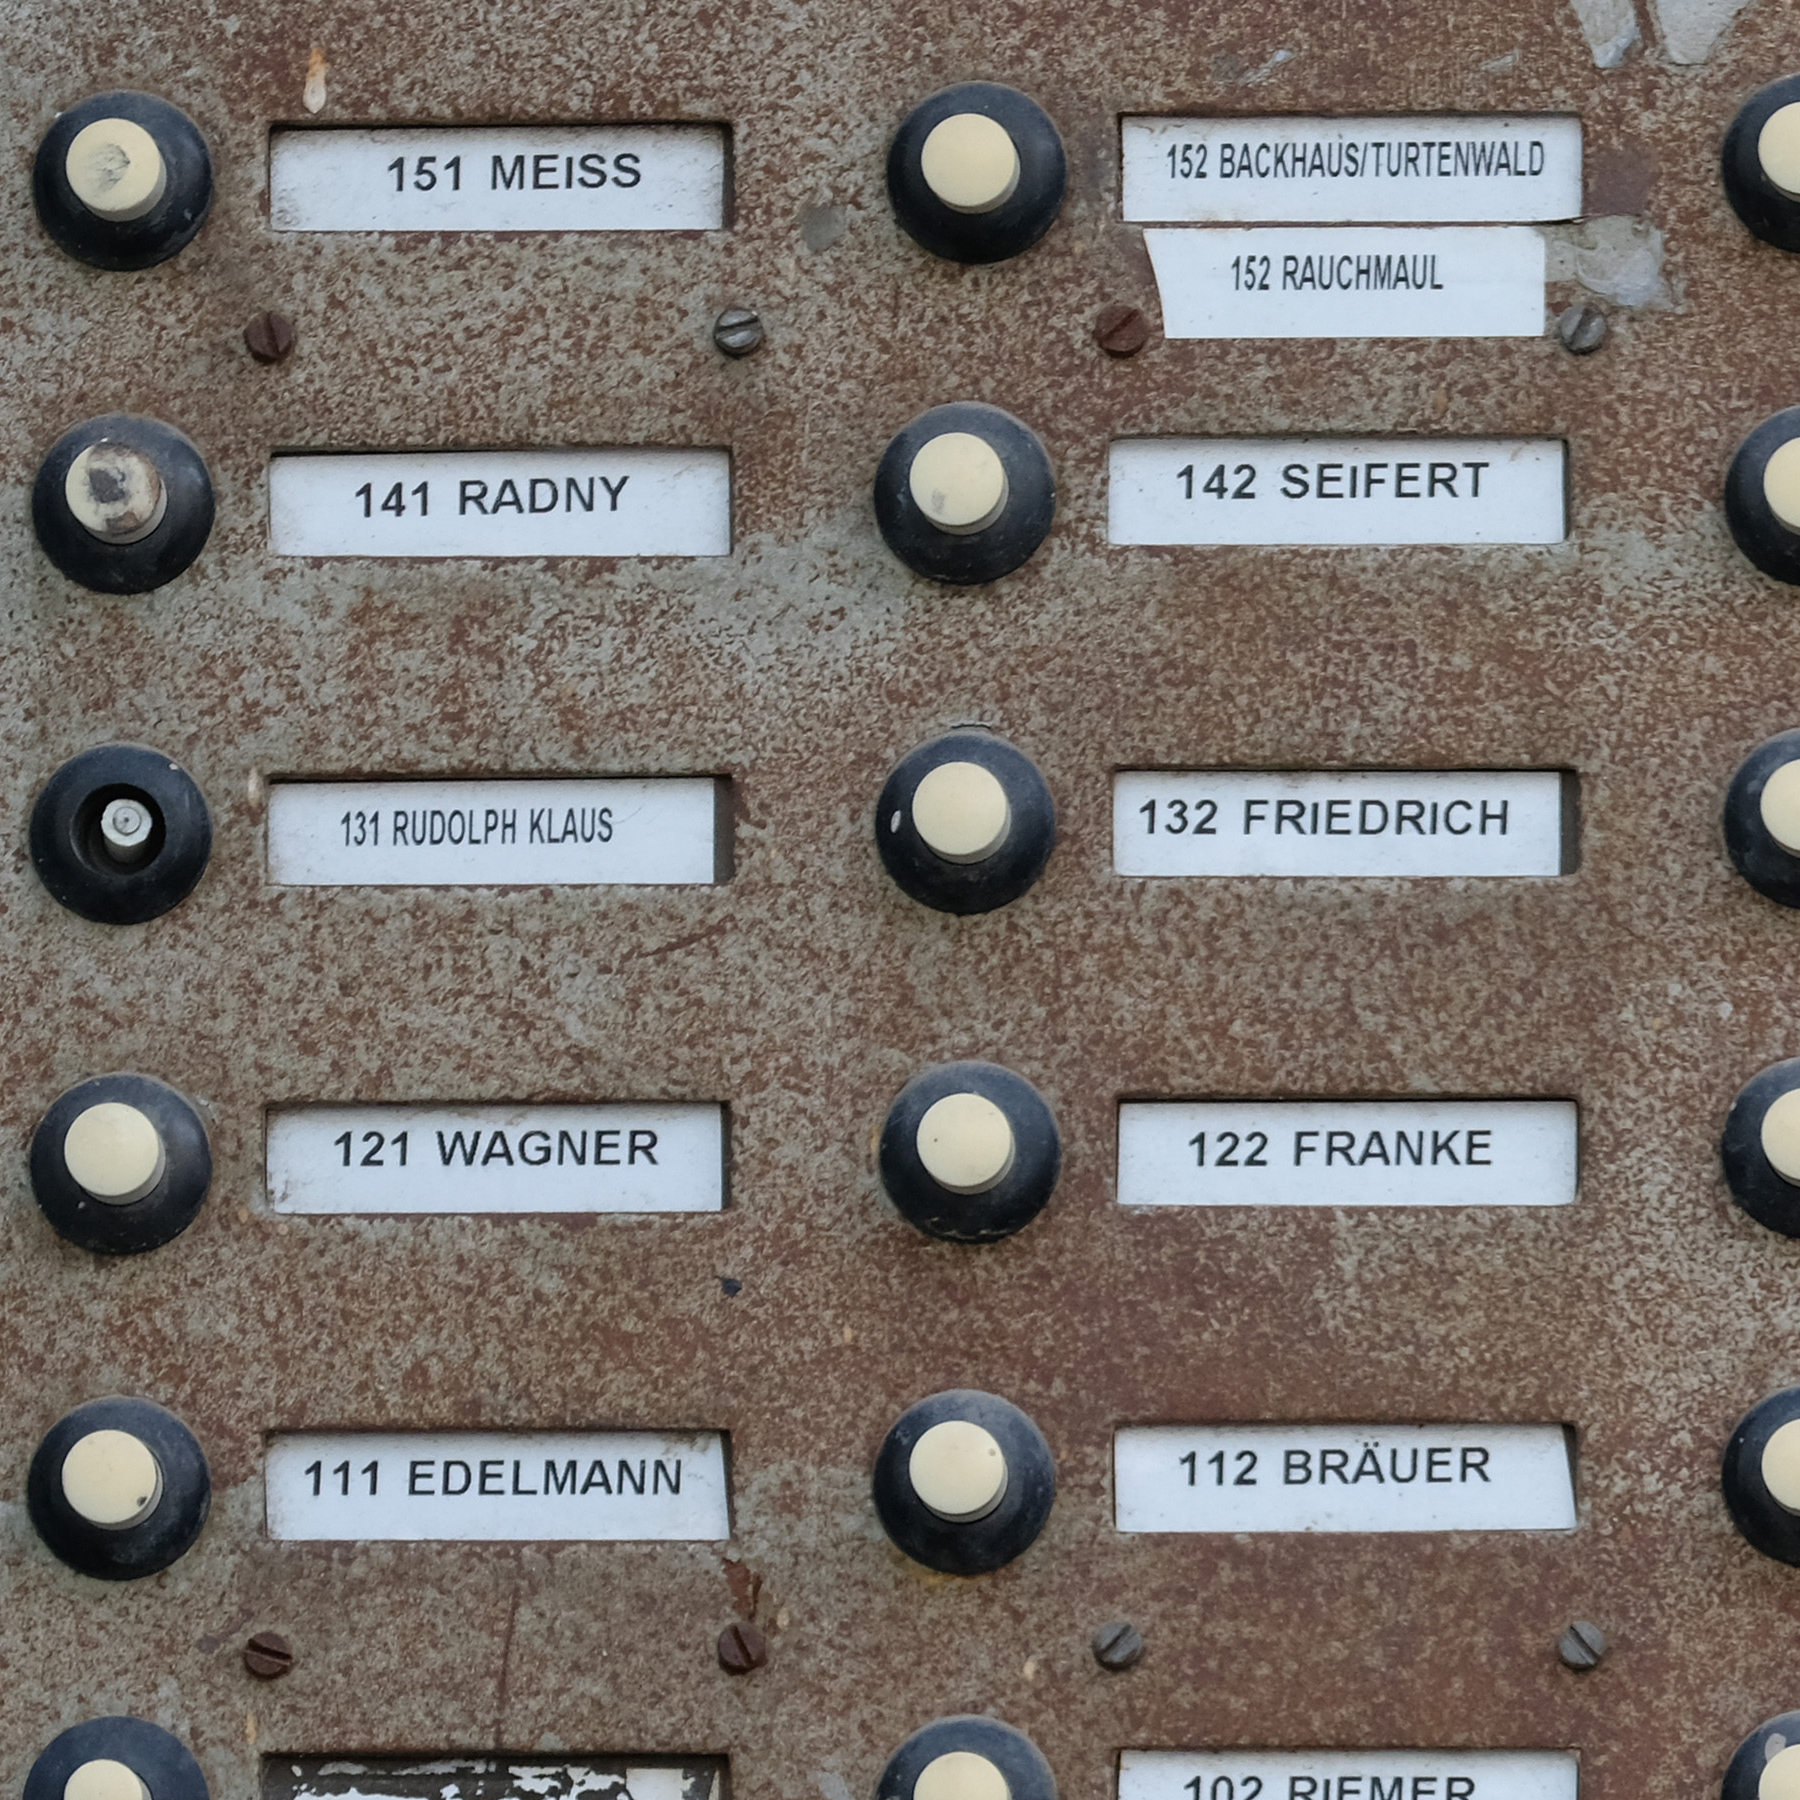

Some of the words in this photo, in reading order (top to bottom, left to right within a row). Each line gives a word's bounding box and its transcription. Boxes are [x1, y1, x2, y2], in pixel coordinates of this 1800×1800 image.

[386, 156, 464, 192] 151
[490, 153, 642, 190] MEISS
[1166, 143, 1209, 179] 152
[1219, 141, 1545, 178] BACKHAUS/TURTENWALD
[1230, 256, 1271, 290] 152
[1281, 254, 1443, 290] RAUCHMAUL
[354, 481, 431, 518] 141
[458, 476, 629, 515] RADNY
[1174, 464, 1257, 501] 142
[1279, 461, 1490, 499] SEIFERT
[340, 811, 380, 847] 131
[392, 808, 517, 845] RUDOLPH
[529, 807, 613, 844] KLAUS
[1138, 799, 1217, 836] 132
[1243, 799, 1509, 836] FRIEDRICH
[333, 1131, 410, 1166] 121
[436, 1130, 659, 1166] WAGNER
[1188, 1132, 1269, 1167] 122
[1293, 1130, 1492, 1167] FRANKE
[303, 1460, 379, 1496] 111
[407, 1459, 681, 1495] EDELMANN
[1178, 1450, 1258, 1486] 112
[1283, 1440, 1491, 1485] BRÄUER
